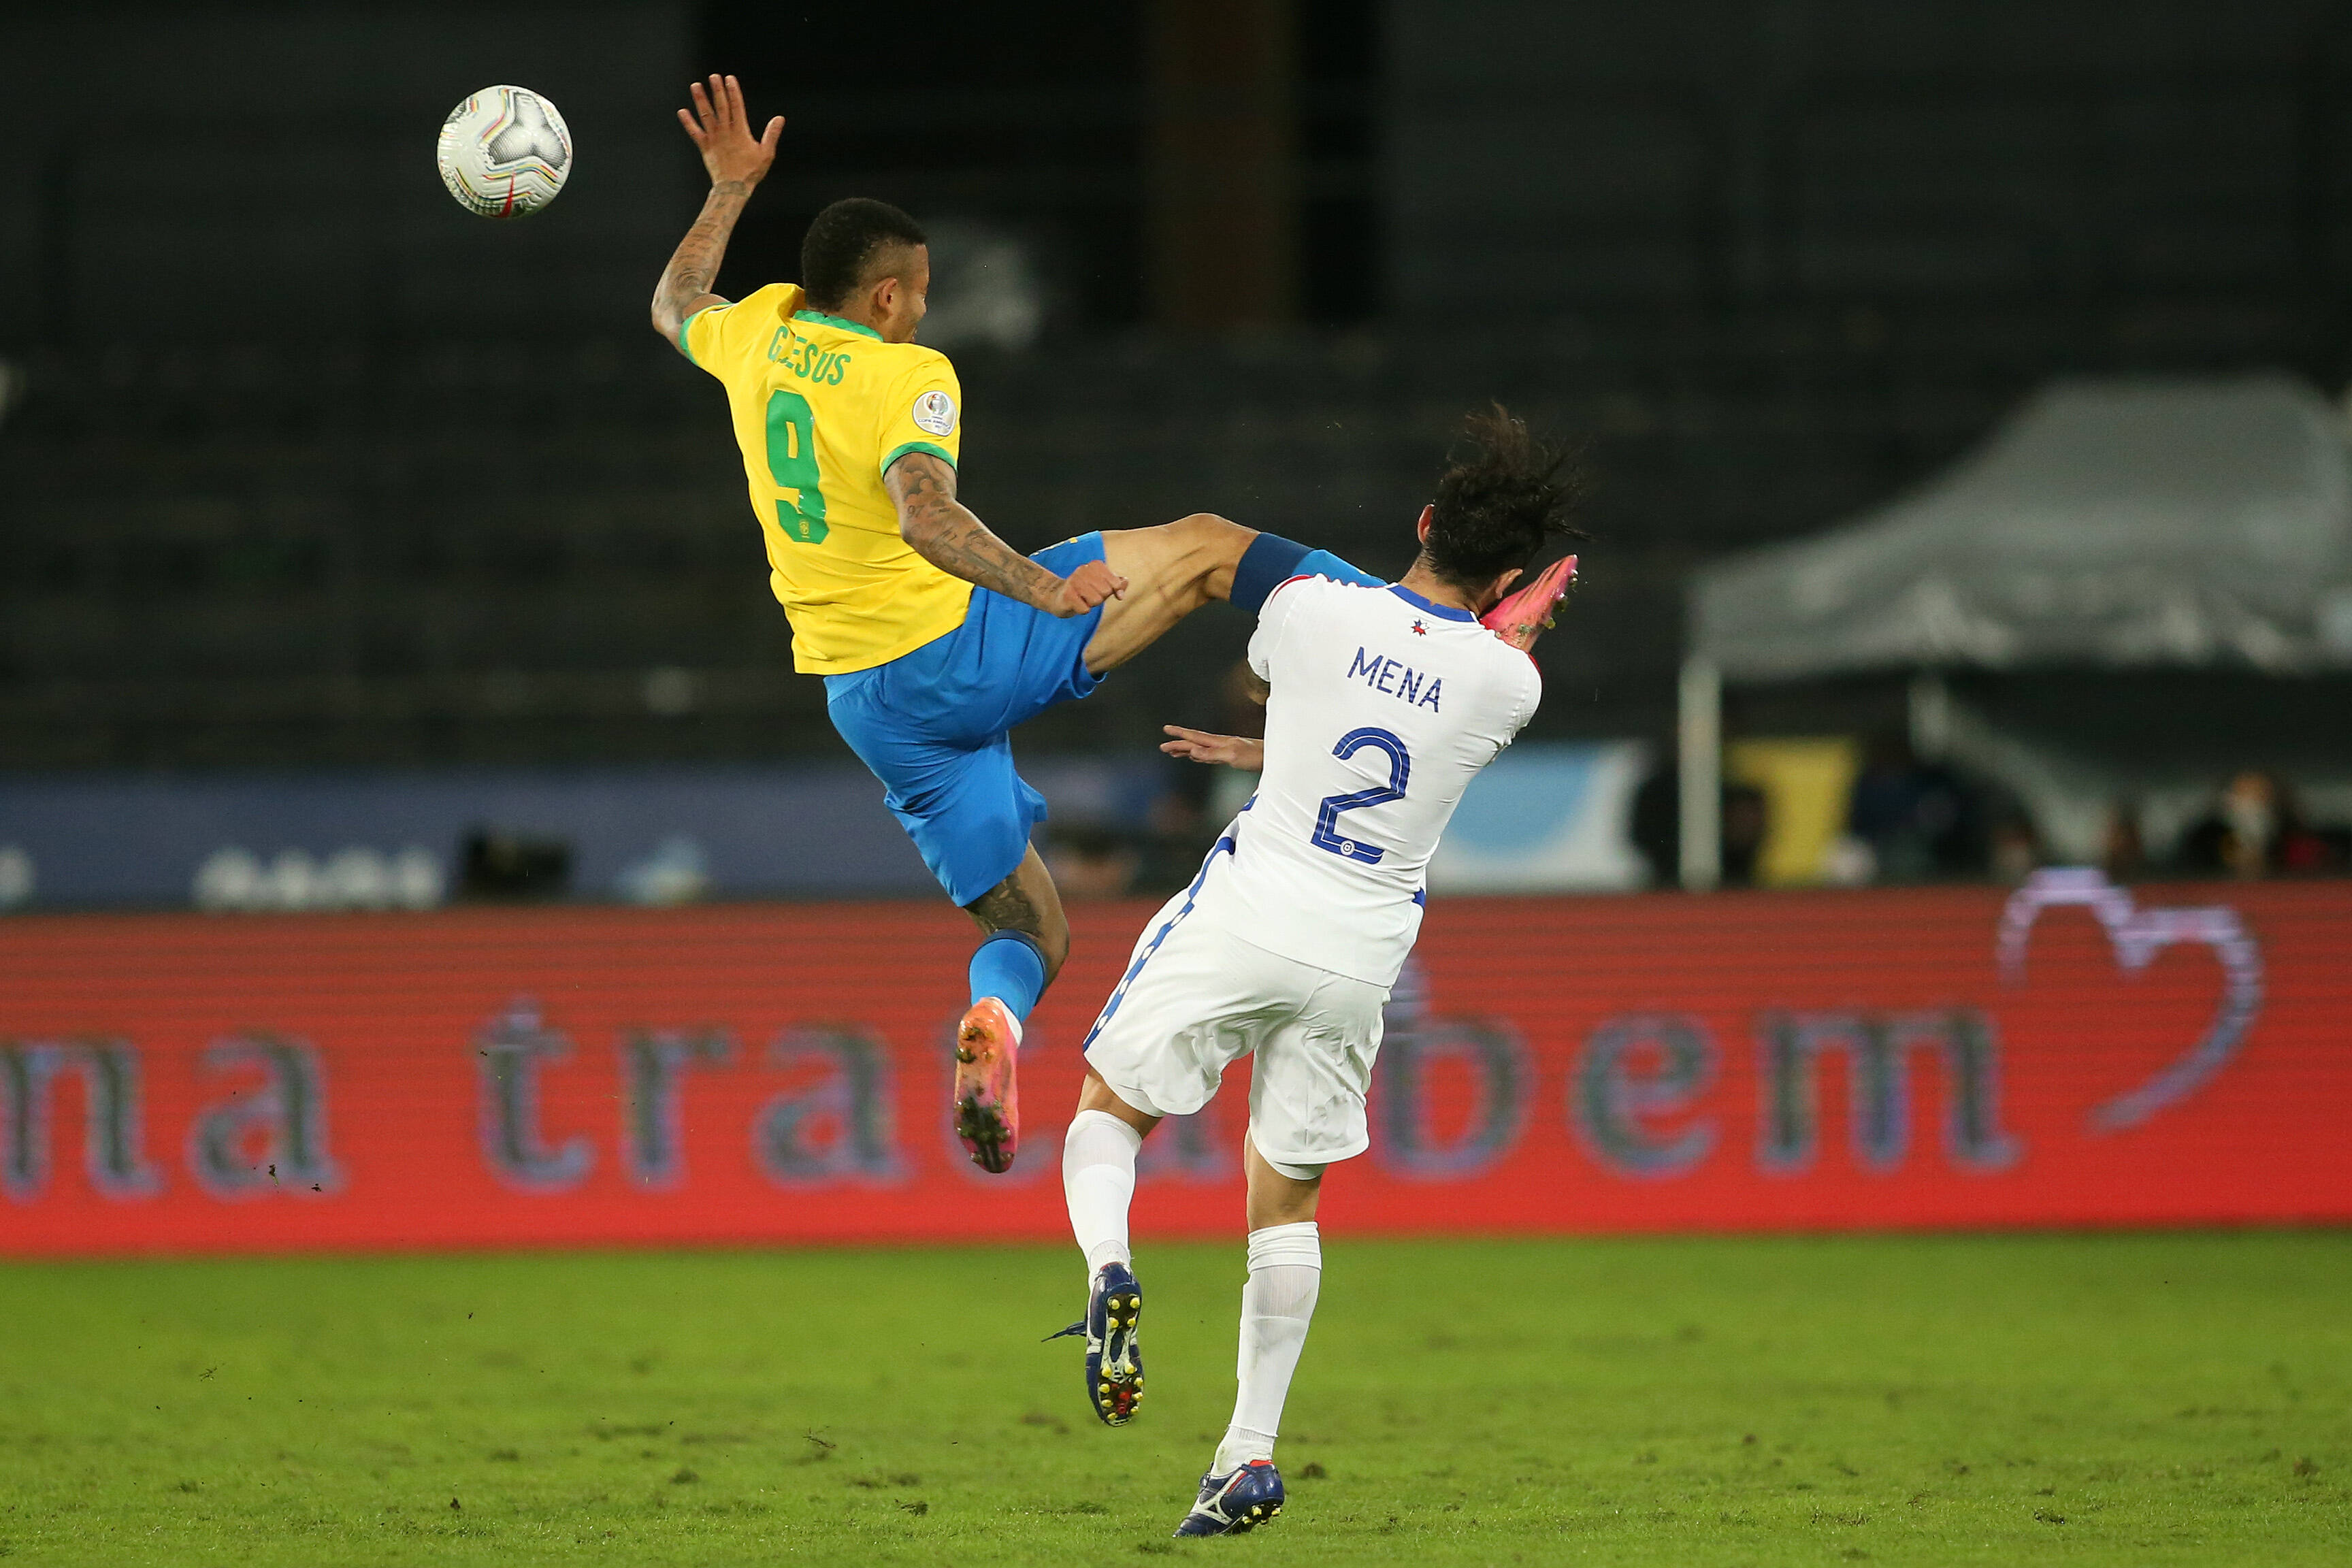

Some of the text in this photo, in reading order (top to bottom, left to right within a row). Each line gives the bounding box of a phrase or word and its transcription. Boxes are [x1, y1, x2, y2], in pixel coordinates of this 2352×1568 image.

[766, 389, 830, 544] 9
[1347, 646, 1443, 713] MENA
[1311, 727, 1411, 865] 2
